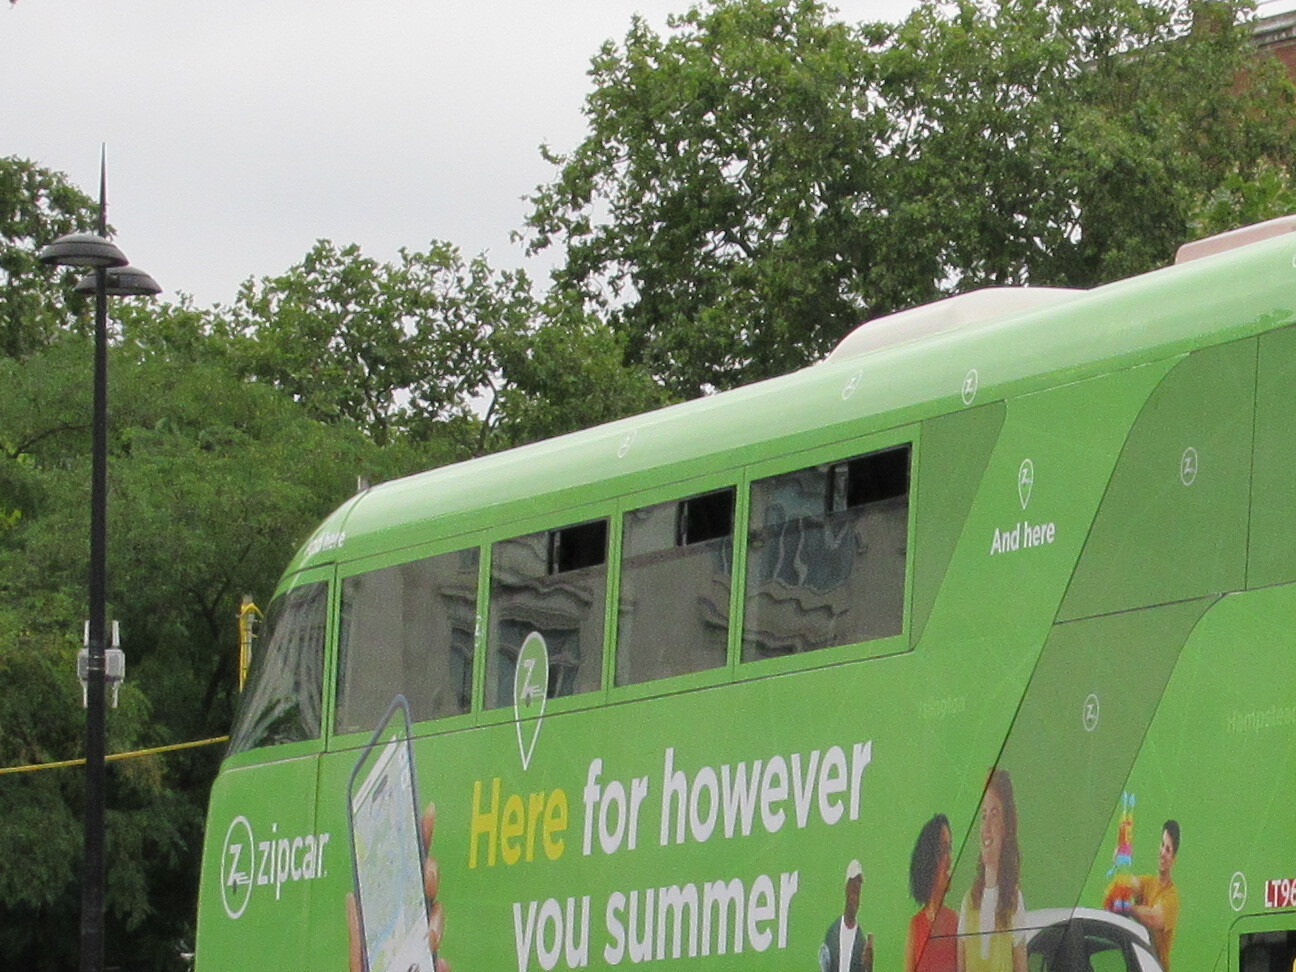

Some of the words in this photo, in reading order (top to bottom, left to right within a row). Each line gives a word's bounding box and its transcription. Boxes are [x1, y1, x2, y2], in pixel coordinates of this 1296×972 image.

[990, 526, 1019, 555] And
[1022, 521, 1055, 549] here
[468, 778, 568, 869] Here
[582, 757, 649, 856] for
[660, 738, 873, 846] however
[258, 821, 328, 899] zipcar
[603, 868, 800, 965] summer
